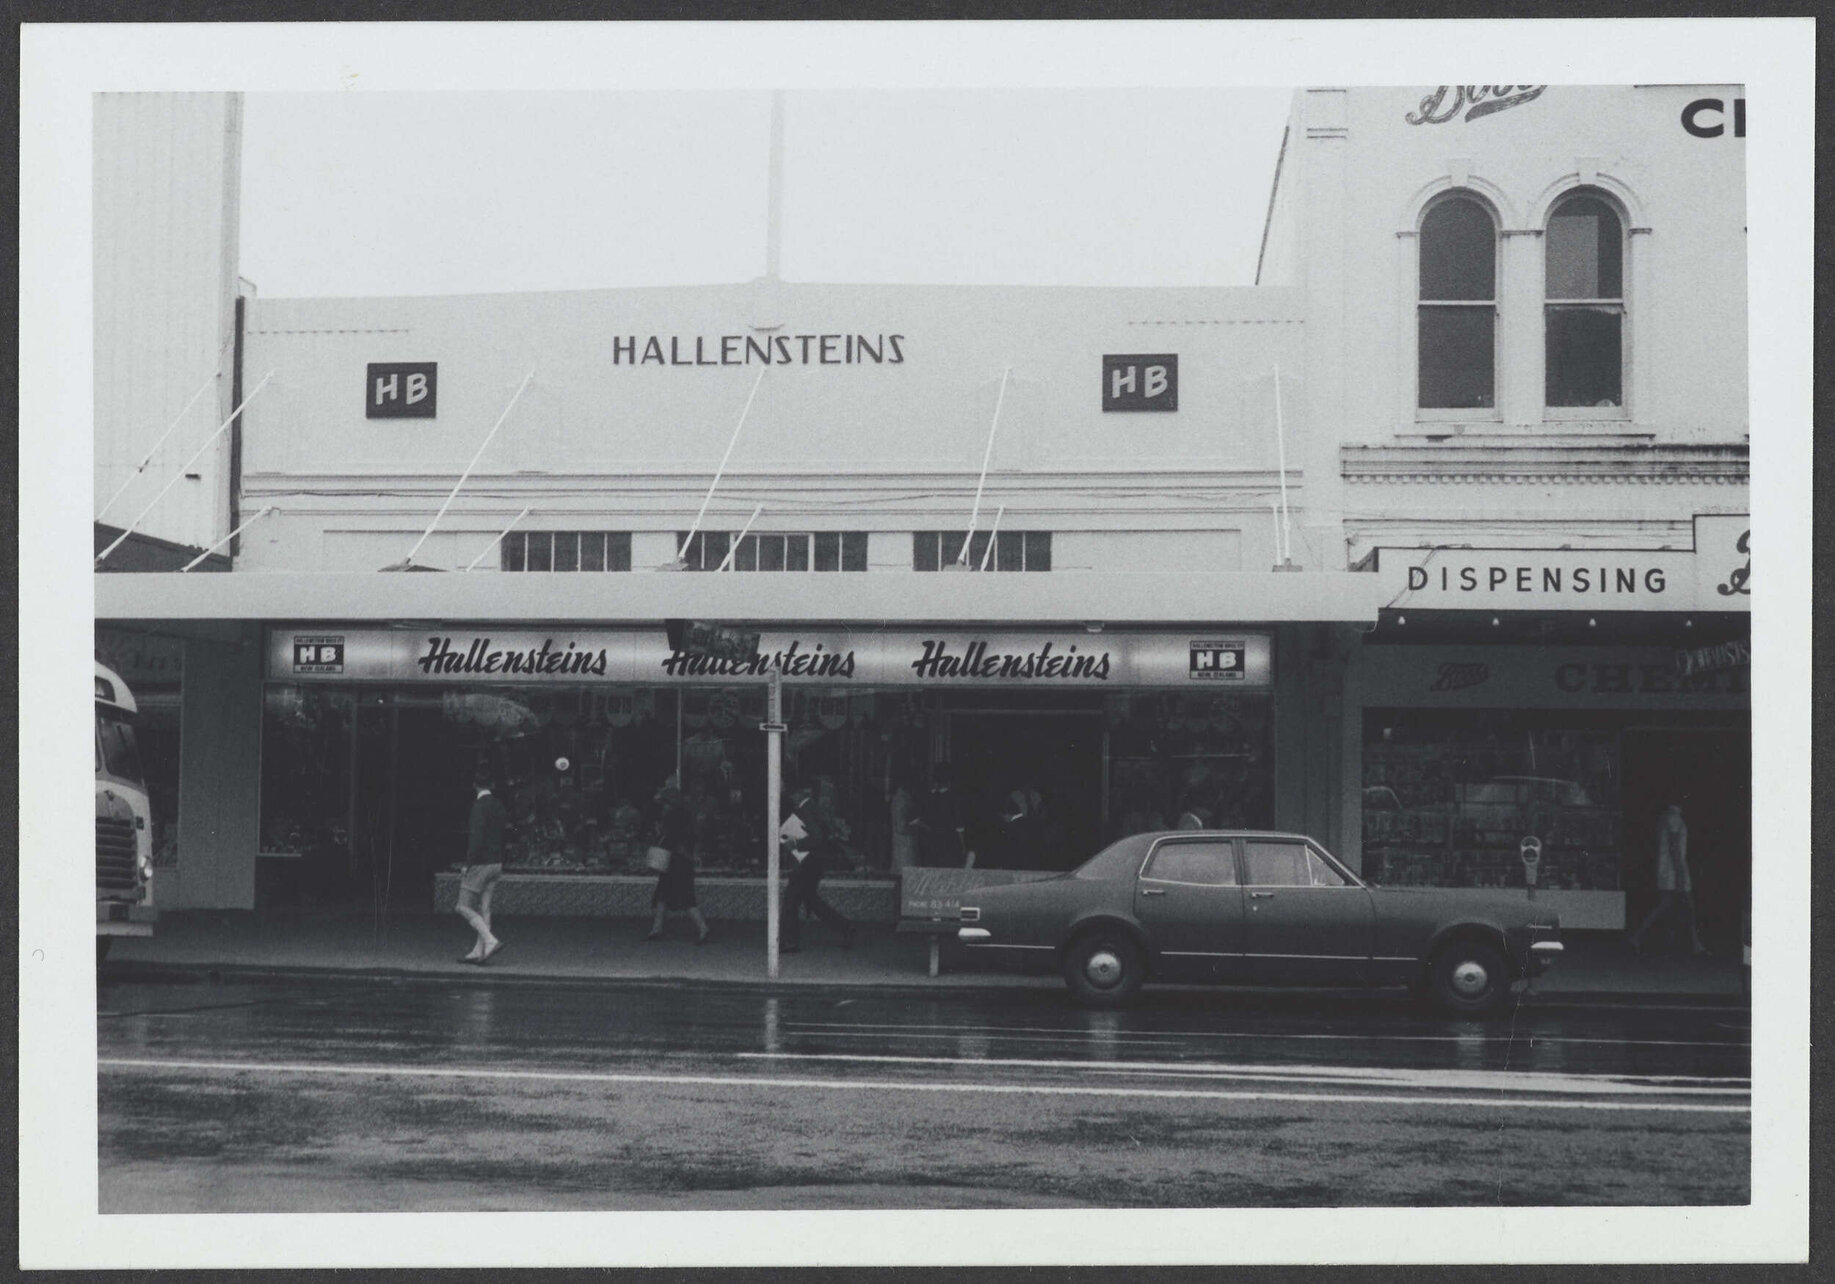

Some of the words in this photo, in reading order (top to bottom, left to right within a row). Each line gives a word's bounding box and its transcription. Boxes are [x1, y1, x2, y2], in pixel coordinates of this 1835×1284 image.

[613, 334, 905, 365] HALLENSTEINS
[376, 373, 428, 405] HB
[1111, 365, 1168, 399] HB
[1408, 566, 1666, 593] DISPENSING
[300, 646, 337, 664] HB
[418, 637, 607, 676] Hallensteins
[911, 640, 1110, 680] Hallensteins
[1196, 651, 1237, 670] HB
